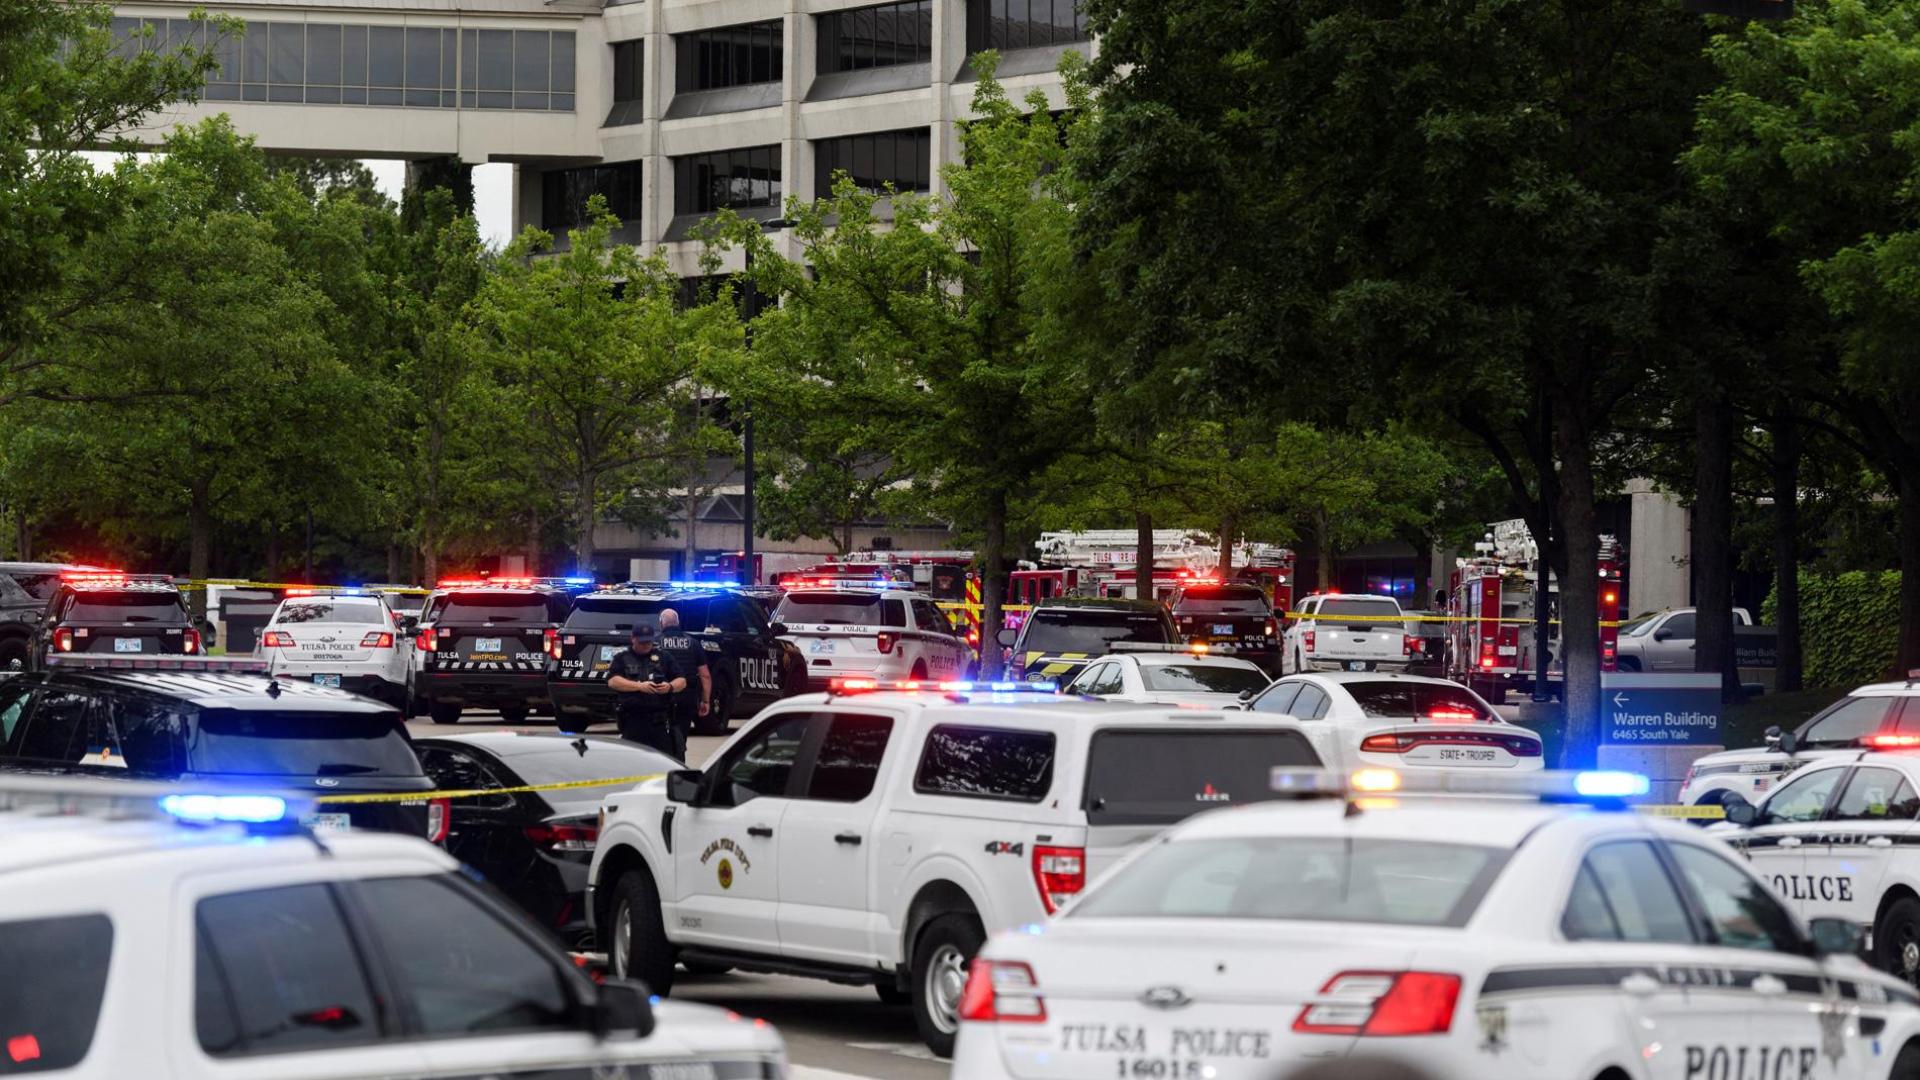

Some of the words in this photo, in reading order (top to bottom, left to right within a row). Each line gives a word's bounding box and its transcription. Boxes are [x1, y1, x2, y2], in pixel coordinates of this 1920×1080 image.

[842, 625, 868, 633] POLICE
[663, 638, 689, 648] POLICE
[561, 660, 584, 668] TULSA
[739, 657, 780, 690] POLICE
[1613, 712, 1662, 726] Warren
[1664, 711, 1717, 729] Building
[1612, 729, 1638, 740] 6465
[1640, 729, 1668, 740] South
[1670, 729, 1690, 740] Yale
[1440, 750, 1460, 760] STATE
[1466, 750, 1496, 761] TROOPER
[1764, 874, 1853, 902] OLICE
[1060, 1025, 1147, 1051] TULSA
[1171, 1029, 1271, 1058] POLICE
[1684, 1045, 1818, 1080] POLICE
